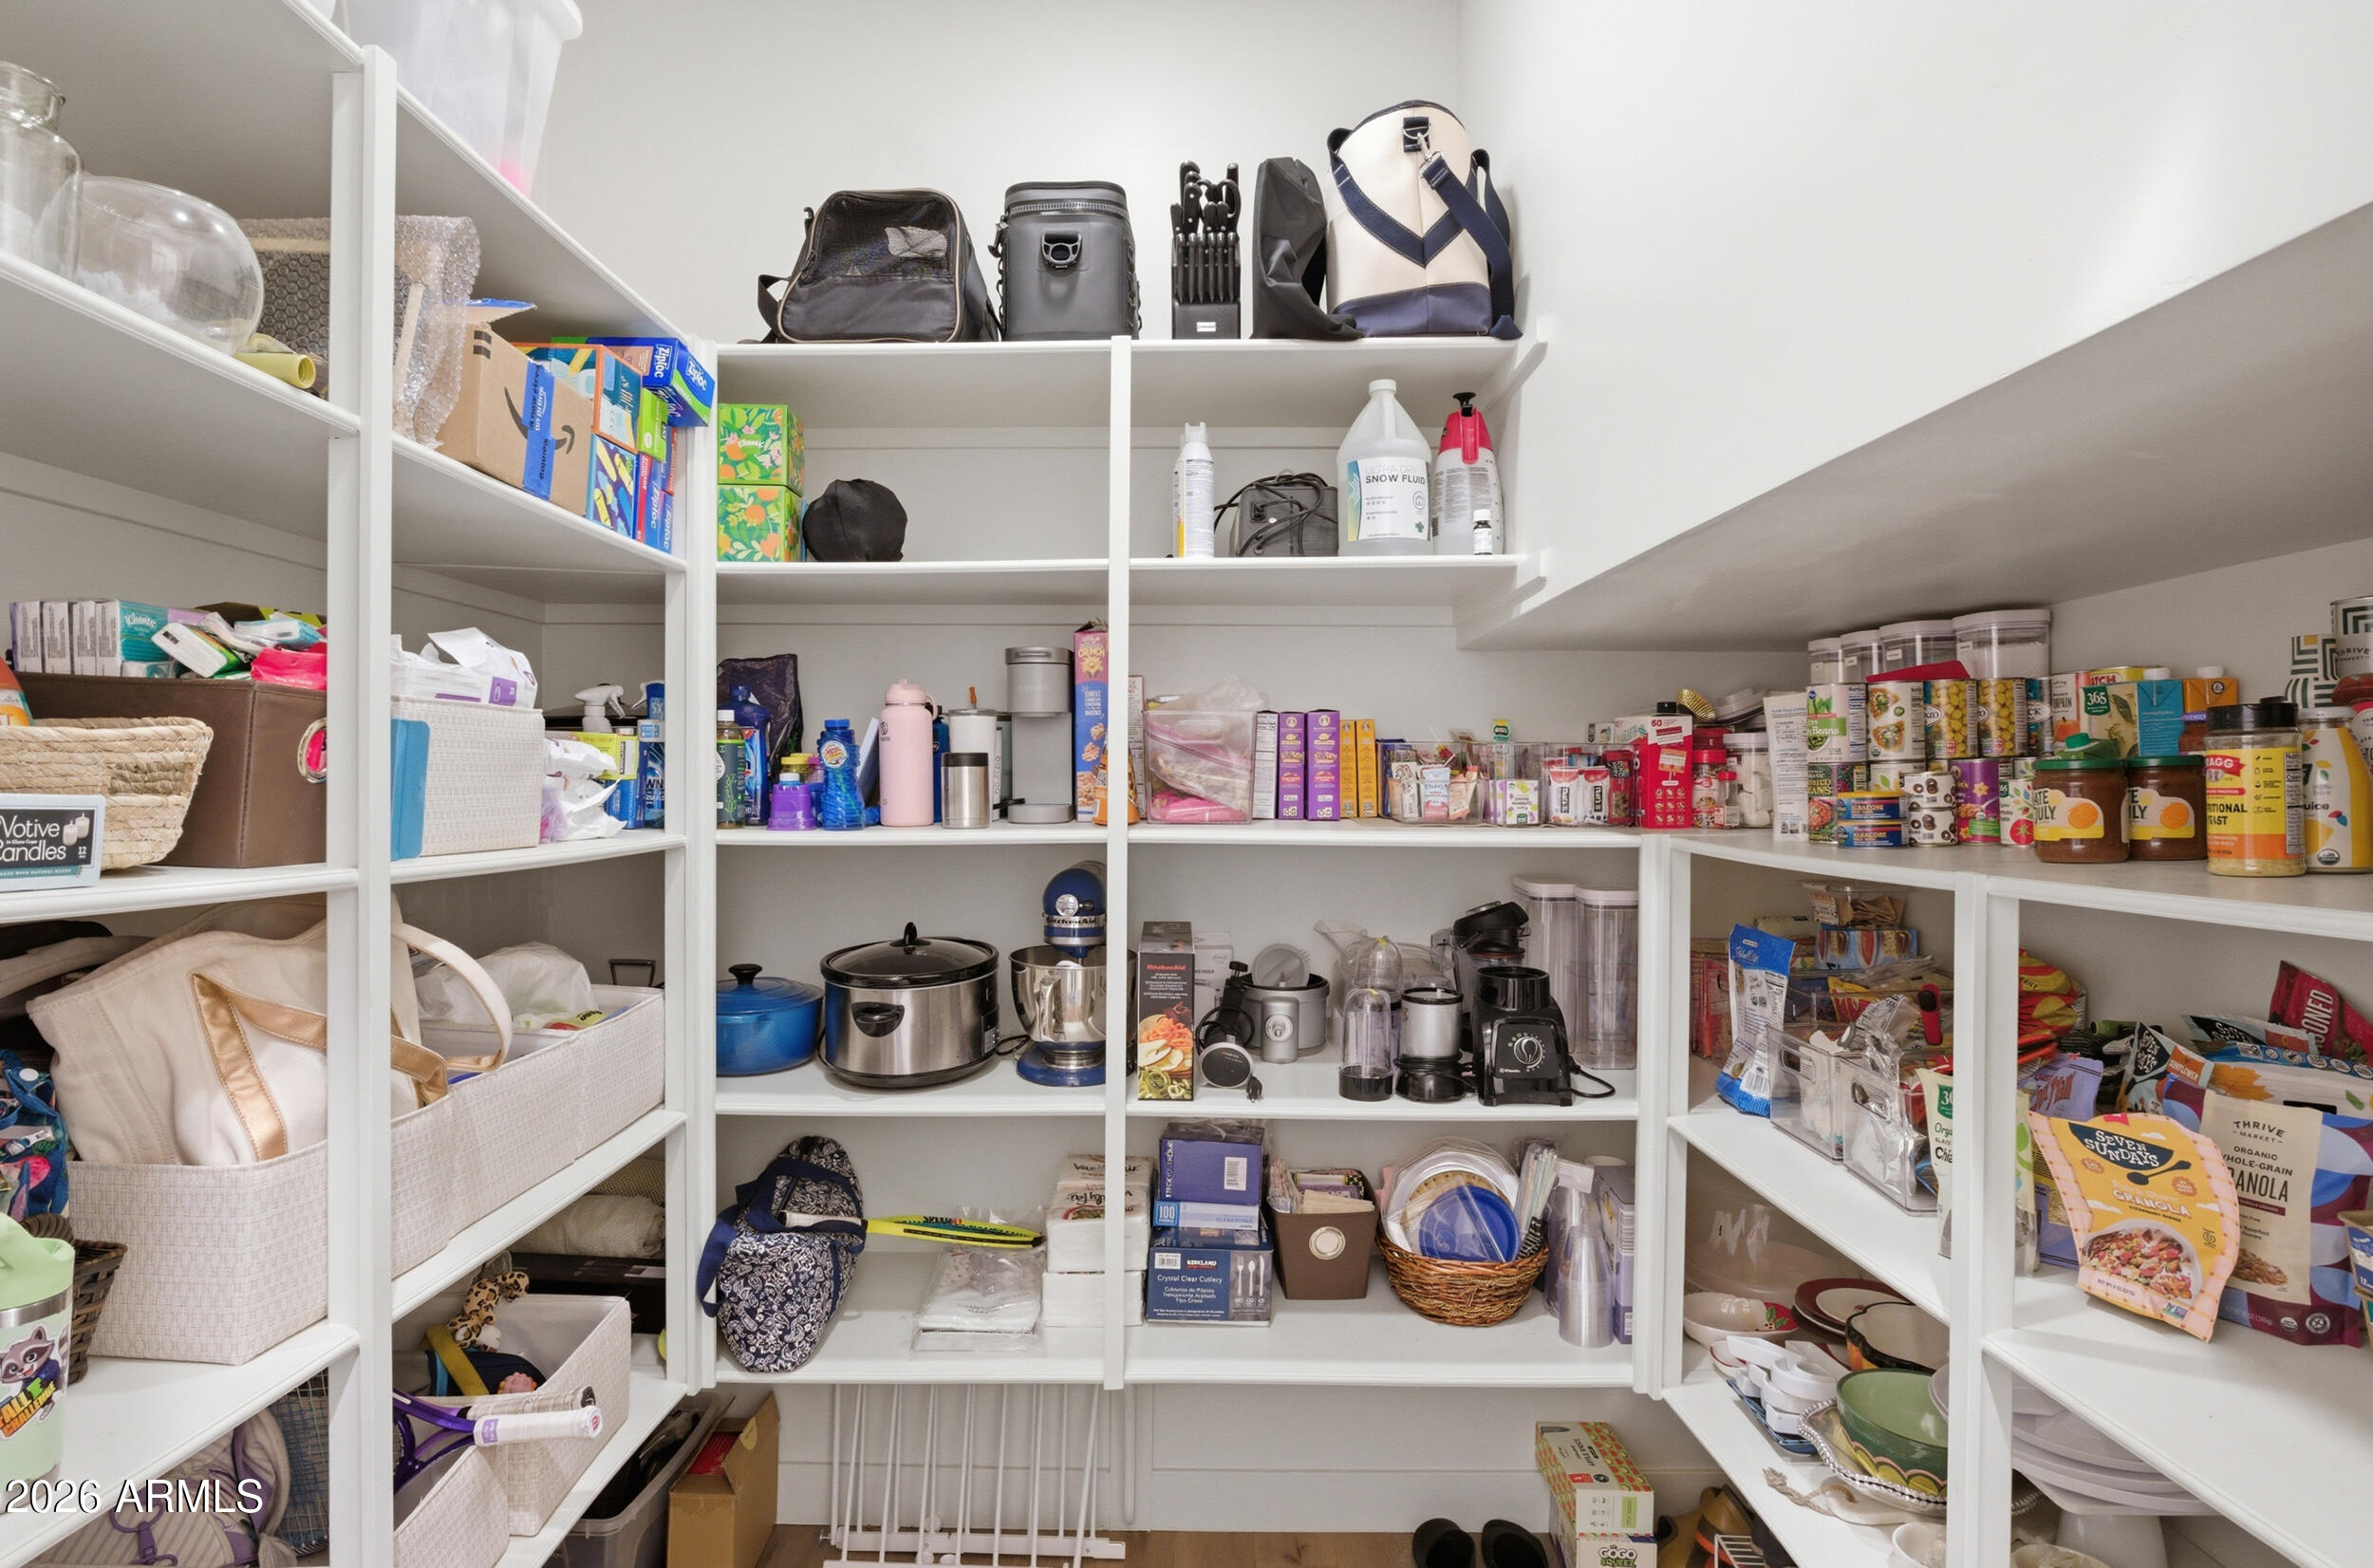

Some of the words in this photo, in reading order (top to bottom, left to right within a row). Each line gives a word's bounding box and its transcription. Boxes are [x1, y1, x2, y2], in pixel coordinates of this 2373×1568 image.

[655, 346, 670, 378] Ziploc
[687, 360, 707, 391] Ziploc
[738, 439, 764, 449] Kleenex
[1366, 475, 1398, 483] SNOW
[1402, 475, 1426, 484] FLUID
[651, 481, 661, 529] Ziploc
[663, 504, 672, 550] Ziploc
[124, 612, 157, 628] Kleenex
[2086, 691, 2107, 706] 365
[2304, 801, 2329, 811] uice
[1, 814, 60, 838] Votive
[0, 839, 67, 863] andles
[78, 846, 86, 854] 12
[2233, 1120, 2286, 1138] THRIVE
[2240, 1130, 2276, 1143] MARKET
[2095, 1129, 2147, 1151] SEVEN
[2084, 1138, 2159, 1167] SUNDAYS
[2233, 1146, 2278, 1161] ORGANIC
[2113, 1188, 2191, 1217] GRANOLA
[1159, 1205, 1175, 1219] 100
[1200, 1276, 1223, 1284] Cutlery
